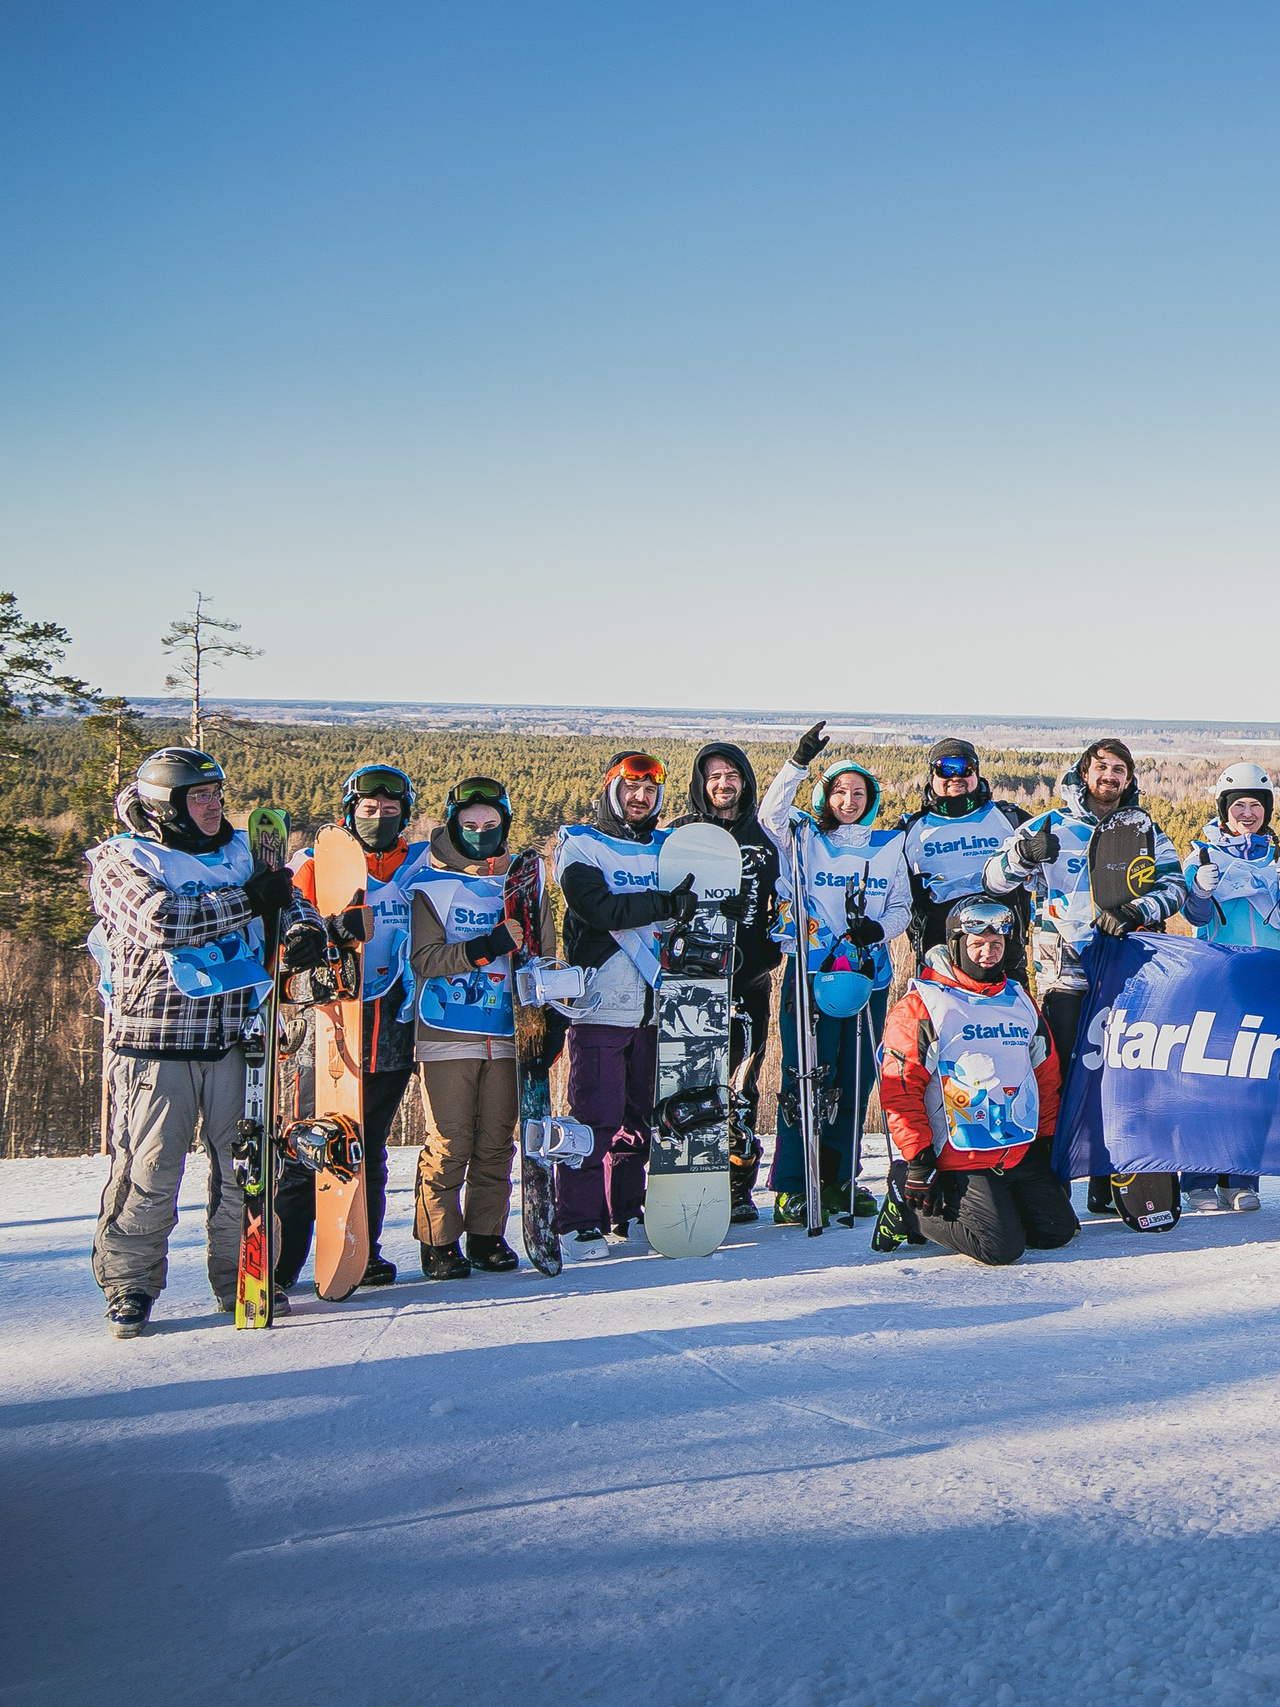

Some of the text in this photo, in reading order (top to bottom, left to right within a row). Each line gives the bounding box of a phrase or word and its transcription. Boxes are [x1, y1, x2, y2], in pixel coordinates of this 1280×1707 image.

[923, 835, 999, 858] StarLine
[613, 870, 658, 887] StarLi
[962, 1022, 1030, 1041] StarLine
